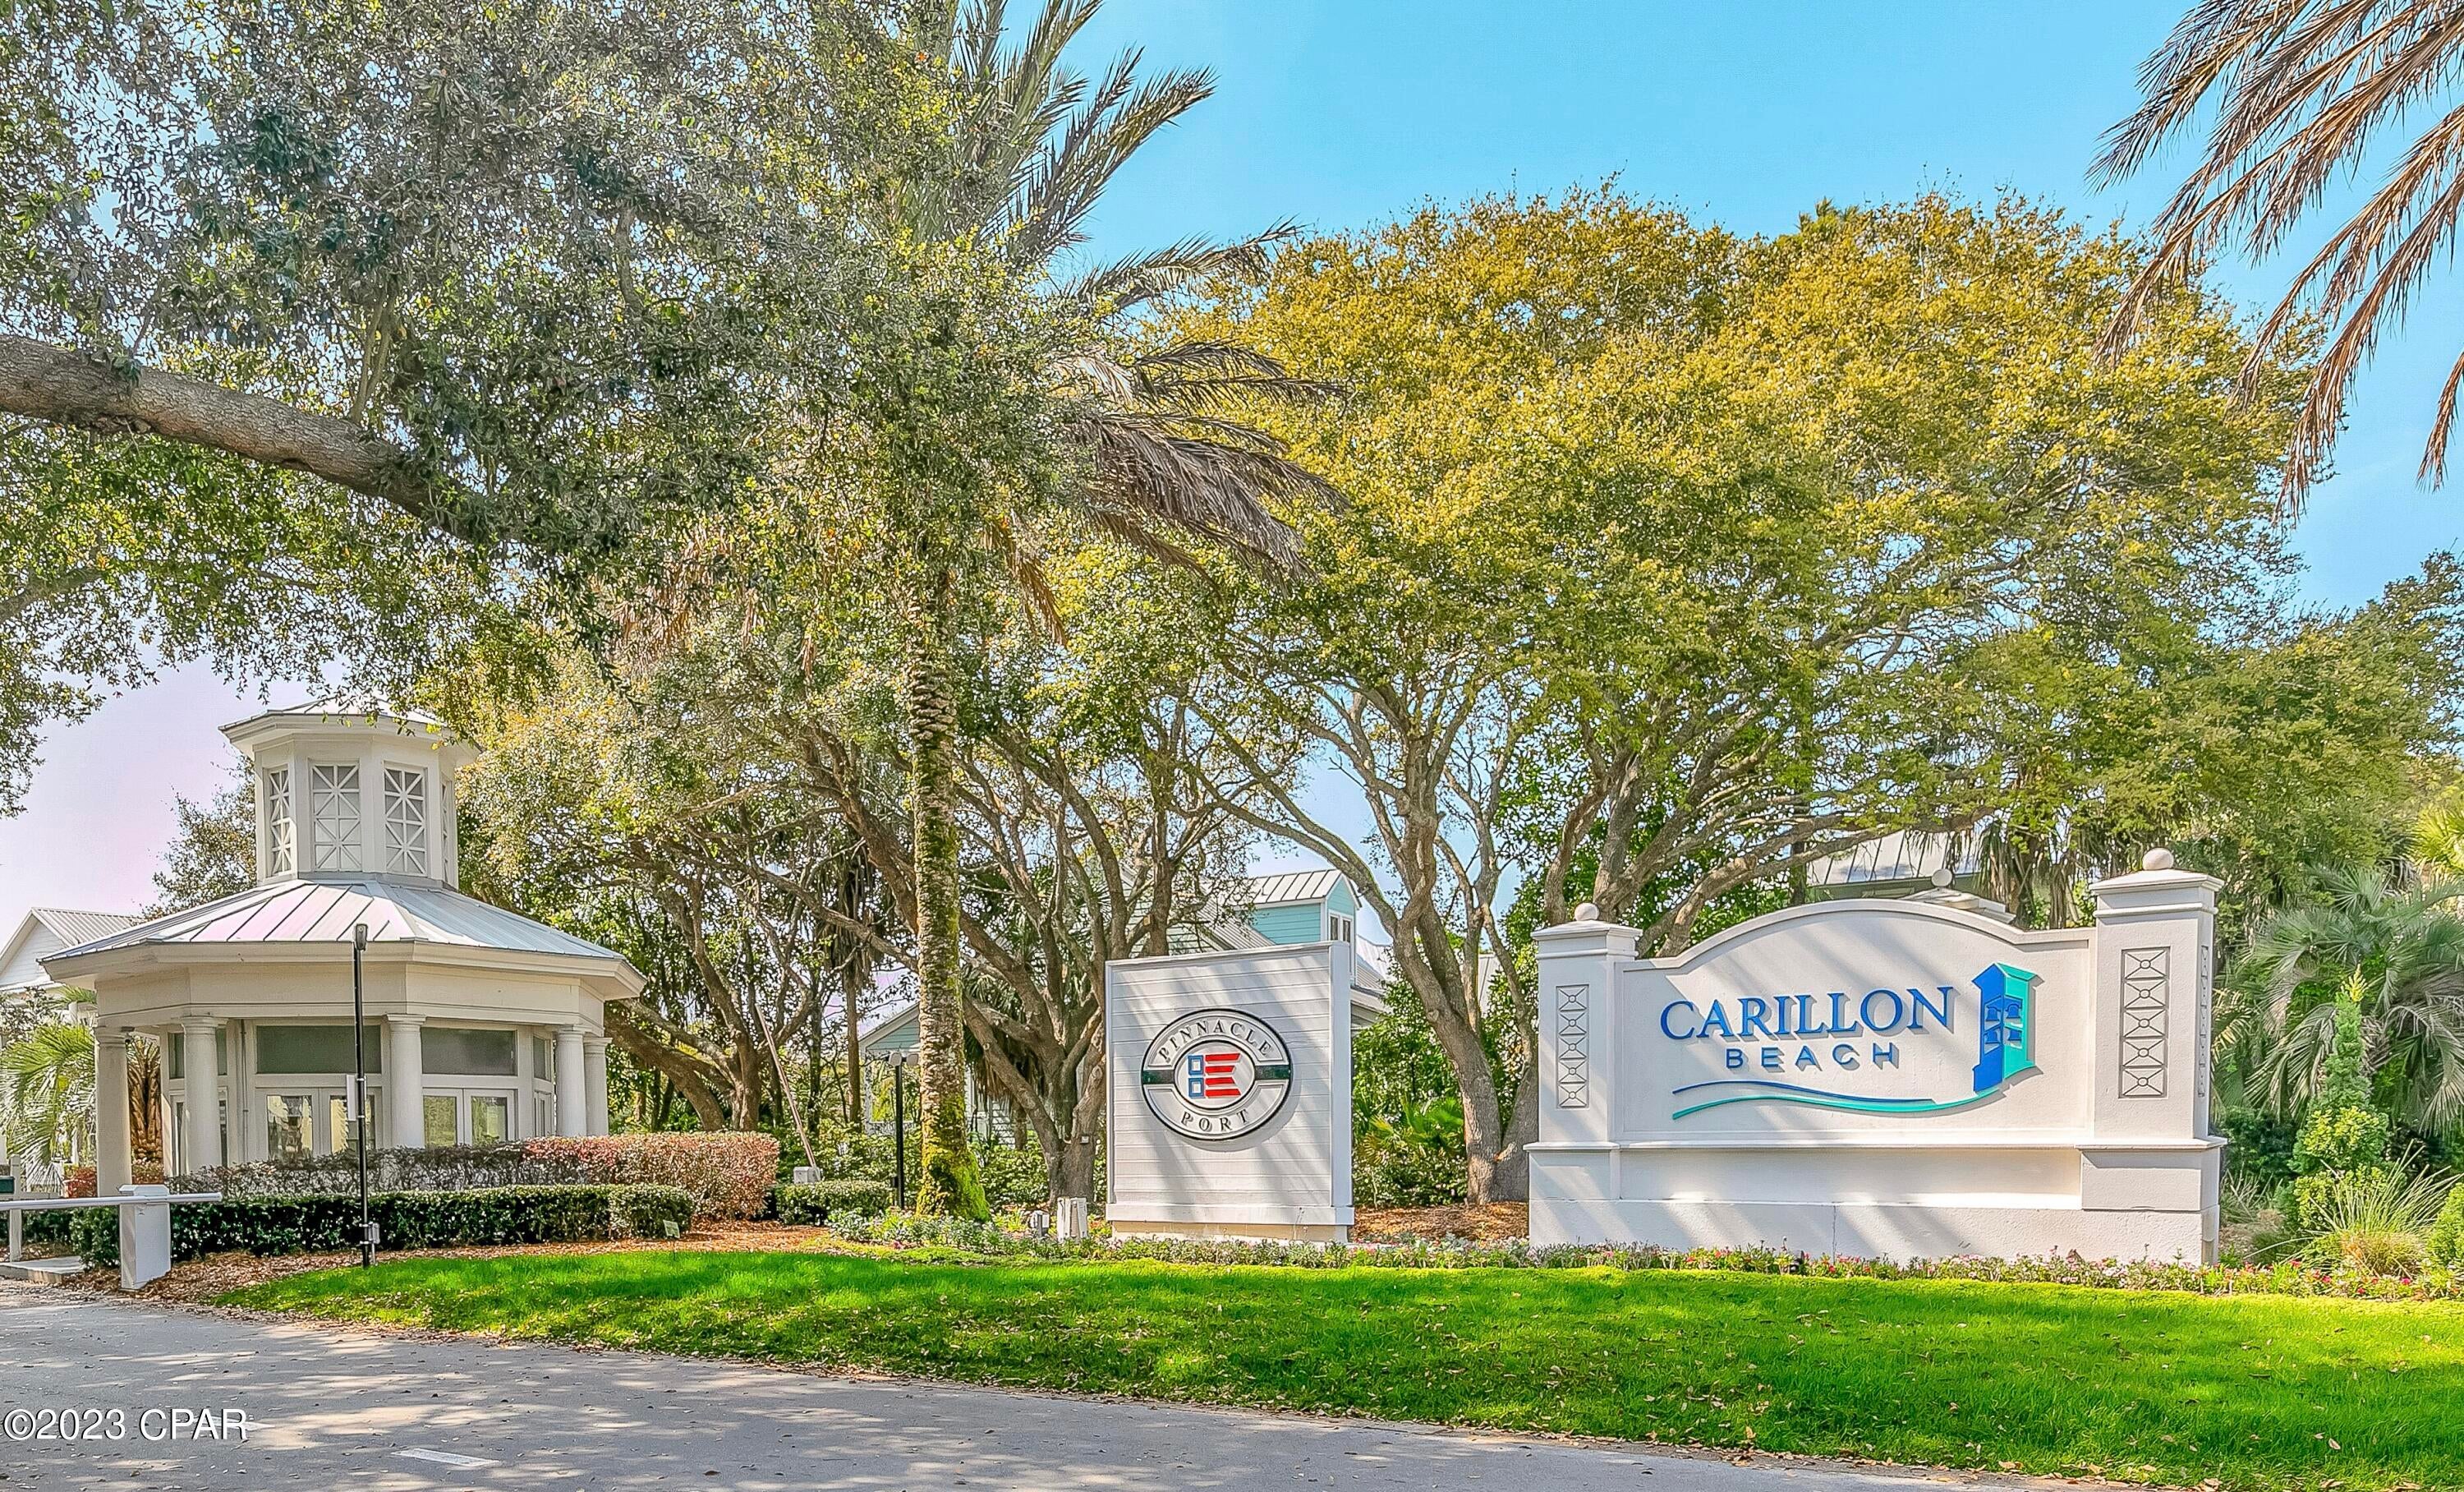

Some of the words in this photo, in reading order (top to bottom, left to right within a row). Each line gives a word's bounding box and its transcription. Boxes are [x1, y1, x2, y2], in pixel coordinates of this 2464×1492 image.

[1660, 987, 1954, 1040] CARILLON
[1158, 1019, 1272, 1063] PINNACLE
[1726, 1042, 1894, 1069] BEACH
[1180, 1109, 1248, 1132] PORT
